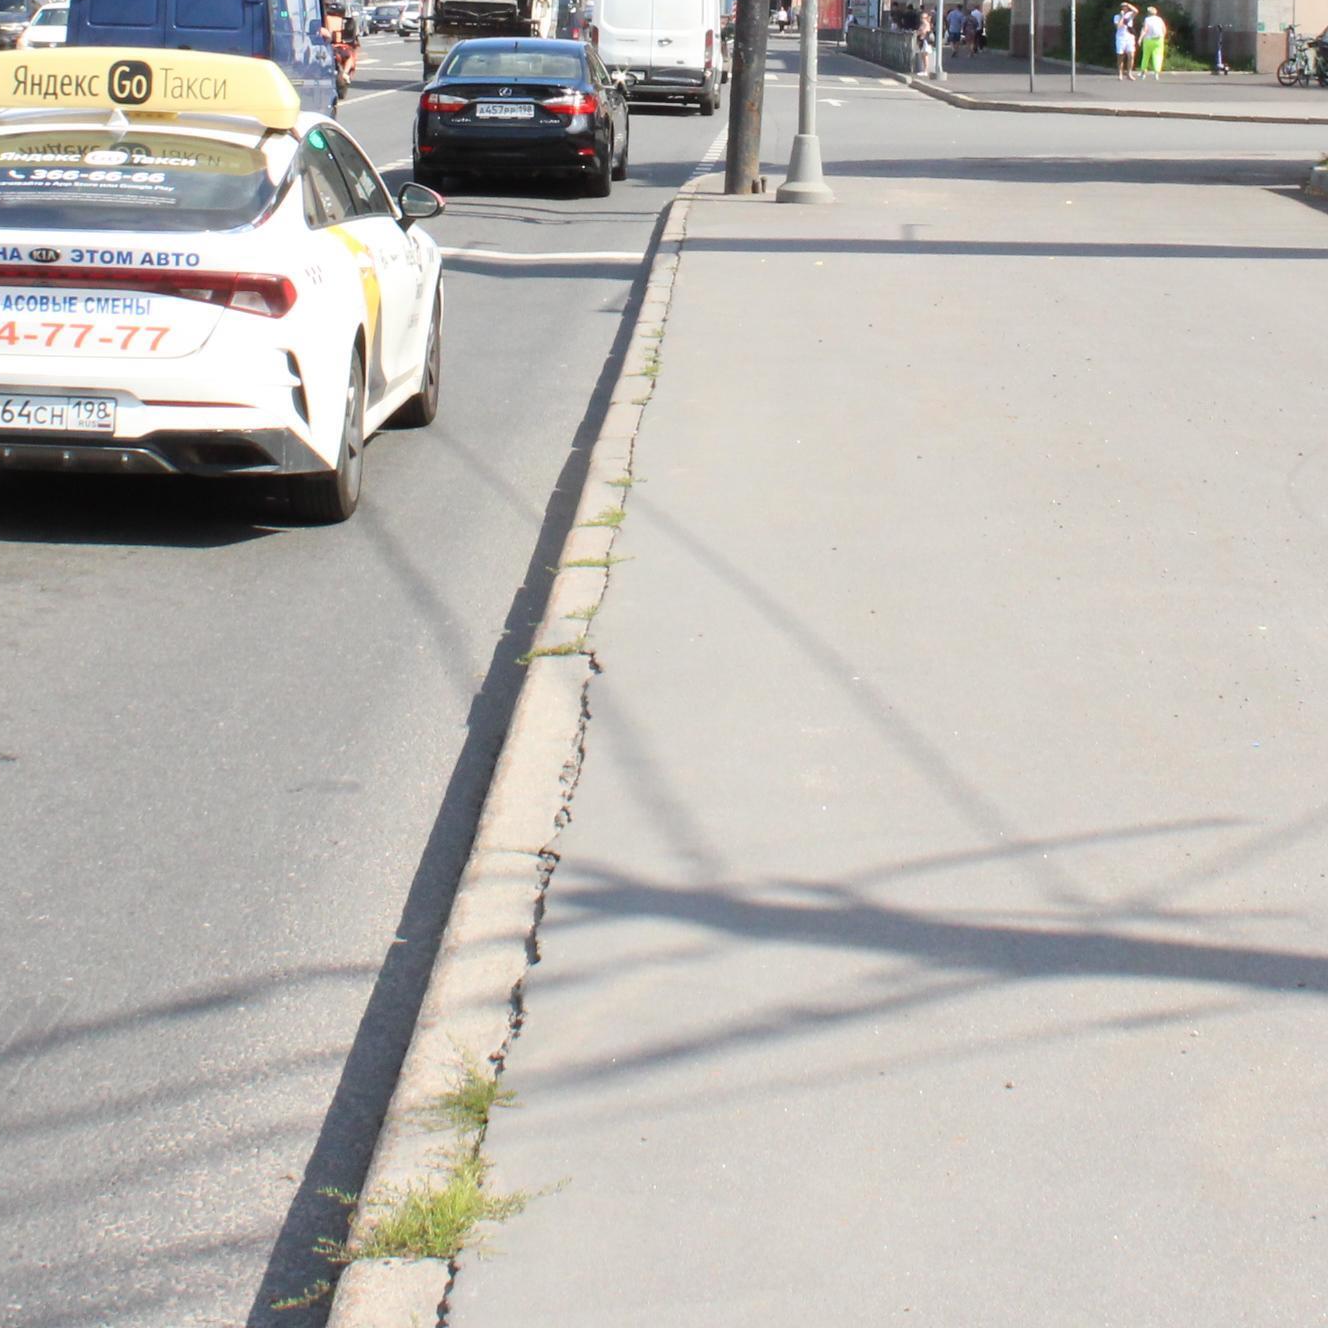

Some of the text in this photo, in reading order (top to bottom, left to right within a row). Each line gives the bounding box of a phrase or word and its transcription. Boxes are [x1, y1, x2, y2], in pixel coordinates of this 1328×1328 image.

[12, 65, 228, 101] Яндекс Go Такси
[132, 154, 197, 166] Такси
[30, 169, 166, 183] 366-66-66
[71, 250, 134, 266] ЭТОМ
[140, 252, 201, 267] АВТО
[84, 297, 151, 316] СМЕНЫ
[72, 400, 109, 420] 198
